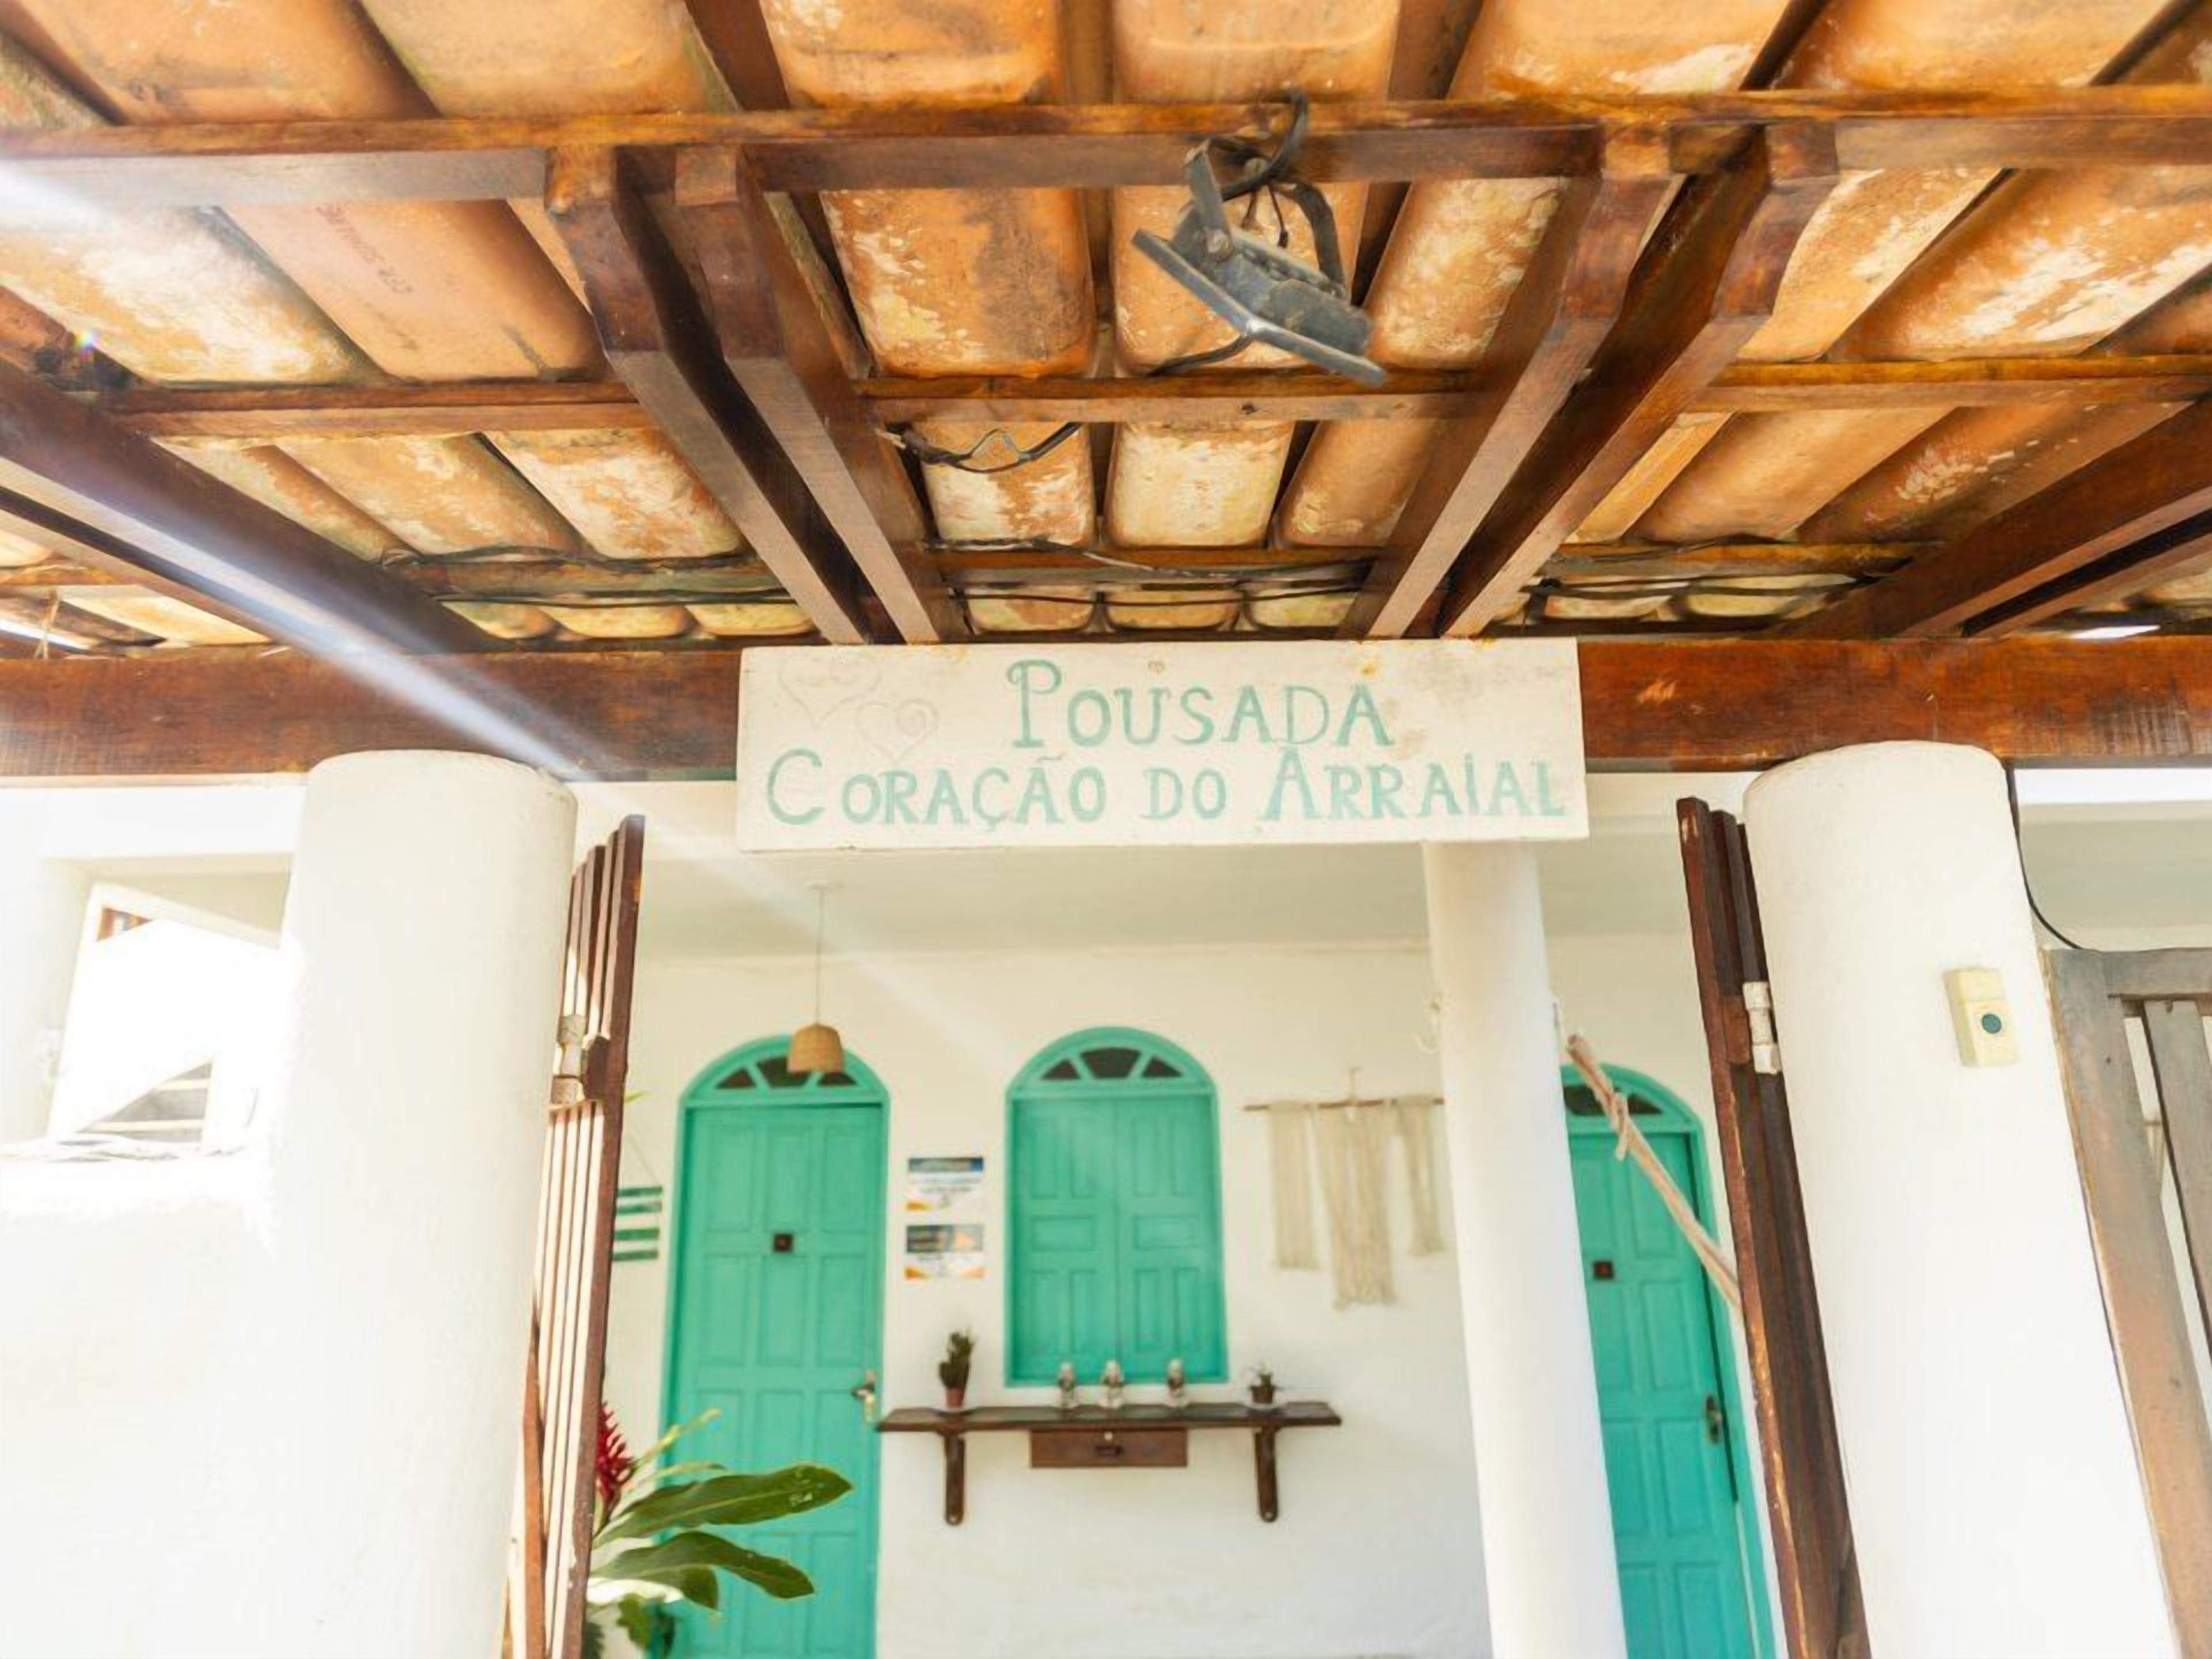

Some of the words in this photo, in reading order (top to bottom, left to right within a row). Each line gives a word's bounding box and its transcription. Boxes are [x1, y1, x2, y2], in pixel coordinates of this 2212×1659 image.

[1007, 659, 1395, 747] POUSADA
[767, 748, 1107, 831] CORAÇÃO
[1140, 766, 1227, 820] DO
[1259, 745, 1566, 821] ARRAIAL
